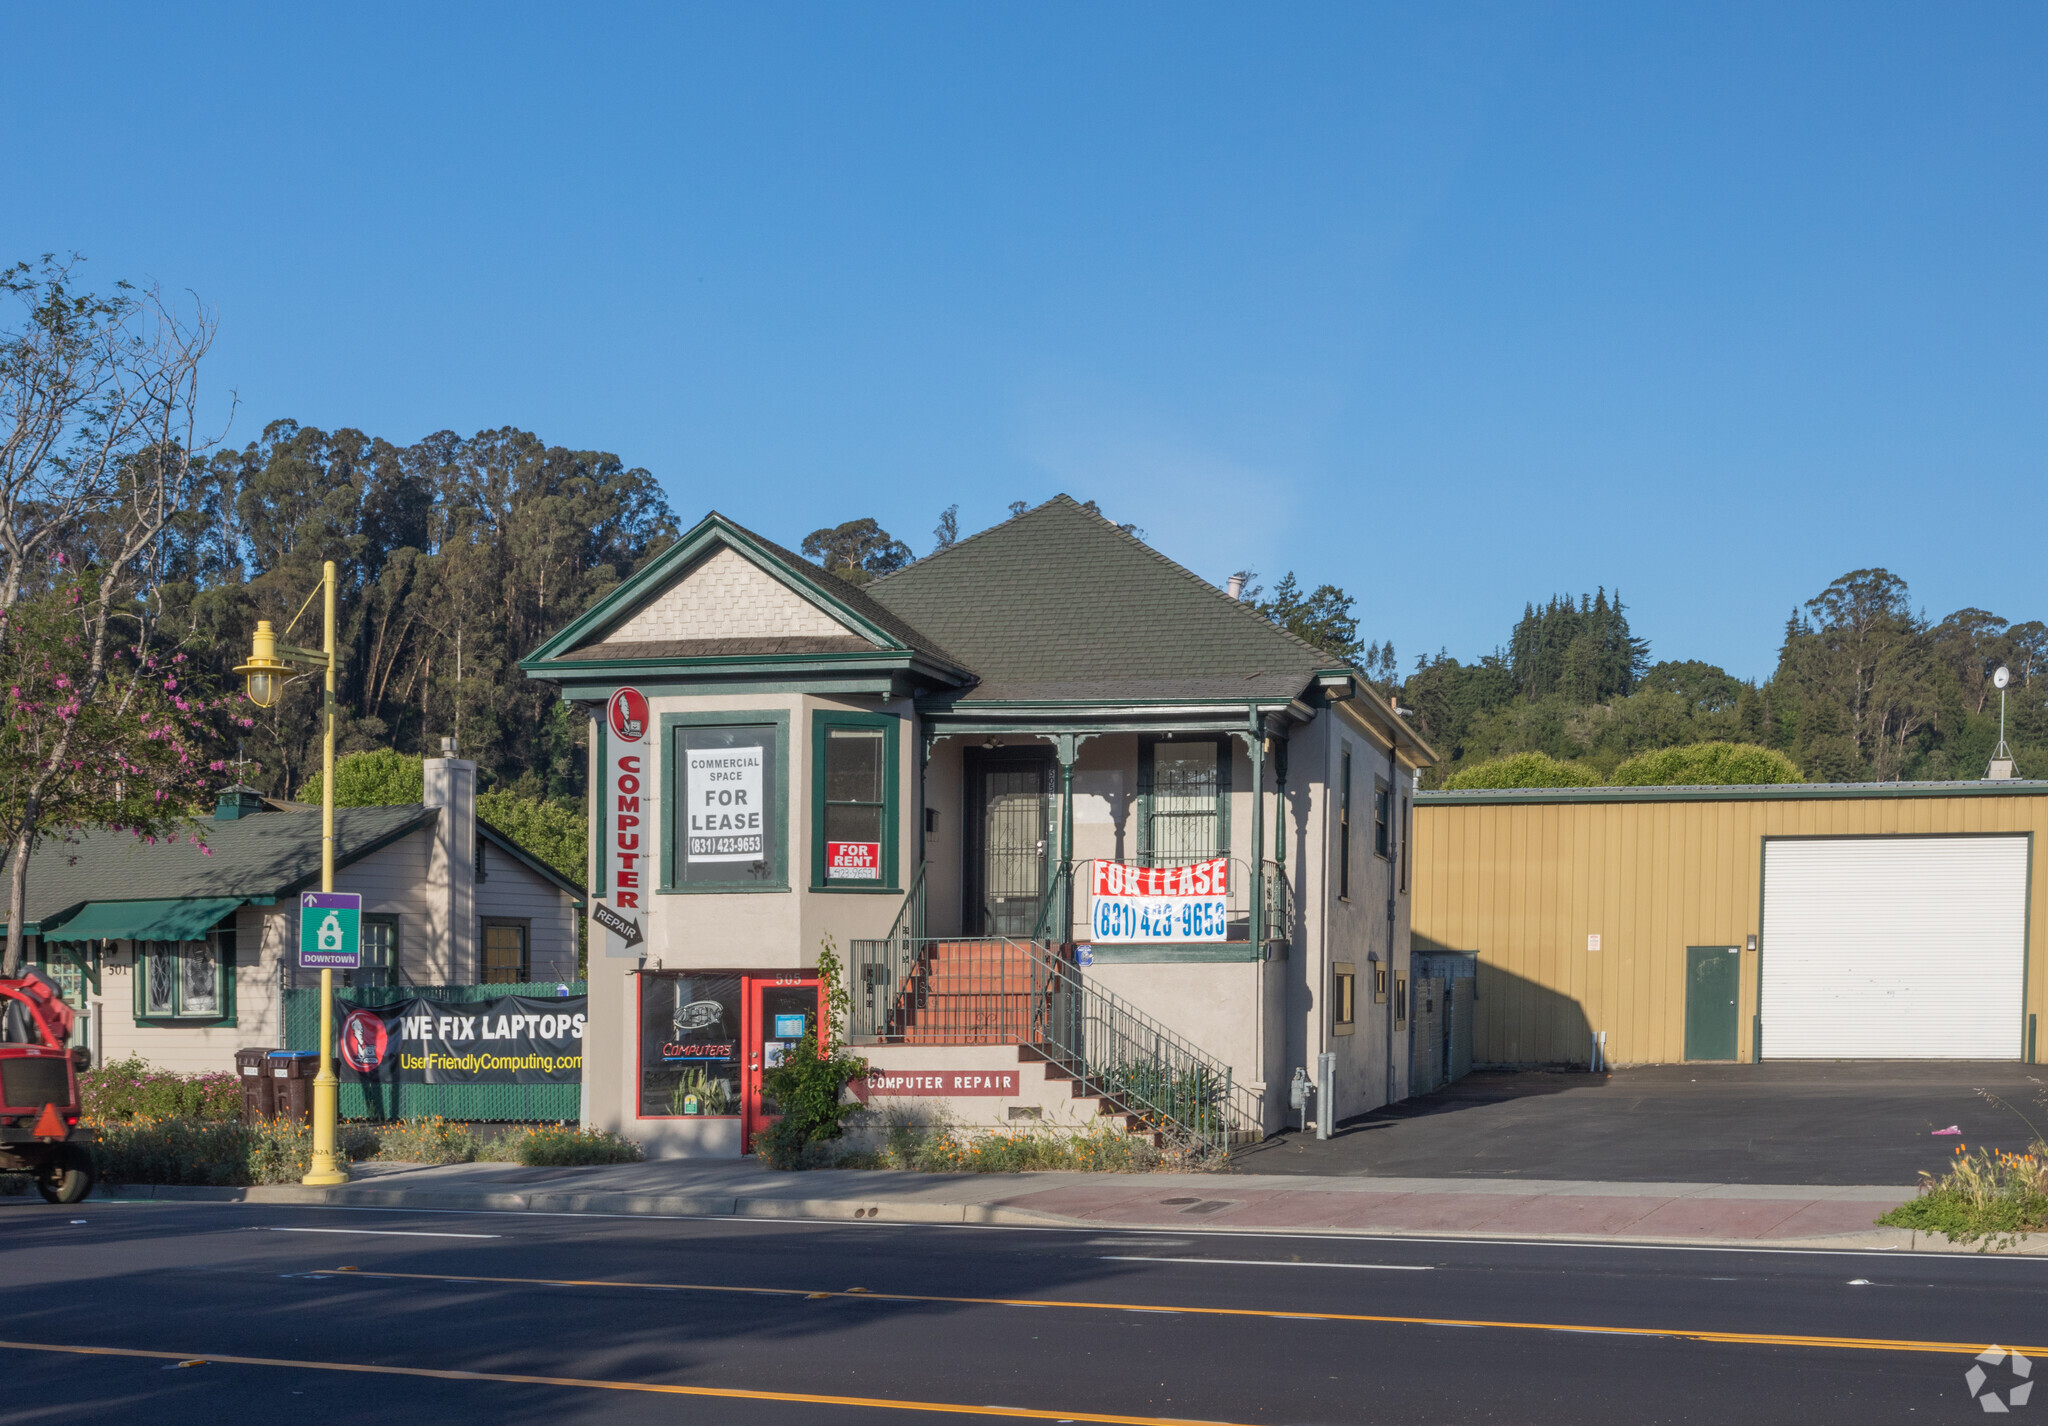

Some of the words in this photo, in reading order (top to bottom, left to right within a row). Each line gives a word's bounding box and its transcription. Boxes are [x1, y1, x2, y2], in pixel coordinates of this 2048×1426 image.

[691, 758, 760, 769] COMMERCIAL
[709, 771, 743, 781] SPACE
[705, 789, 748, 807] FOR
[691, 812, 760, 831] LEASE
[617, 755, 640, 909] COMPUTER
[691, 838, 716, 854] (831)
[717, 836, 761, 853] 423-9653
[839, 844, 869, 856] FOR
[834, 855, 873, 867] RENT
[1093, 860, 1142, 895] FOR
[1149, 861, 1226, 895] LEASE
[597, 908, 637, 939] REPAIR
[1093, 898, 1136, 940] (831)
[1141, 901, 1225, 936] 423-9653
[304, 954, 355, 964] DOWNTOWN
[108, 964, 128, 976] 501
[775, 972, 802, 986] 505
[400, 1015, 433, 1041] WE
[439, 1016, 476, 1041] FIX
[482, 1013, 586, 1040] LAPTOPS
[662, 1043, 732, 1057] COMPUTERS
[954, 1076, 1012, 1088] REPAIR
